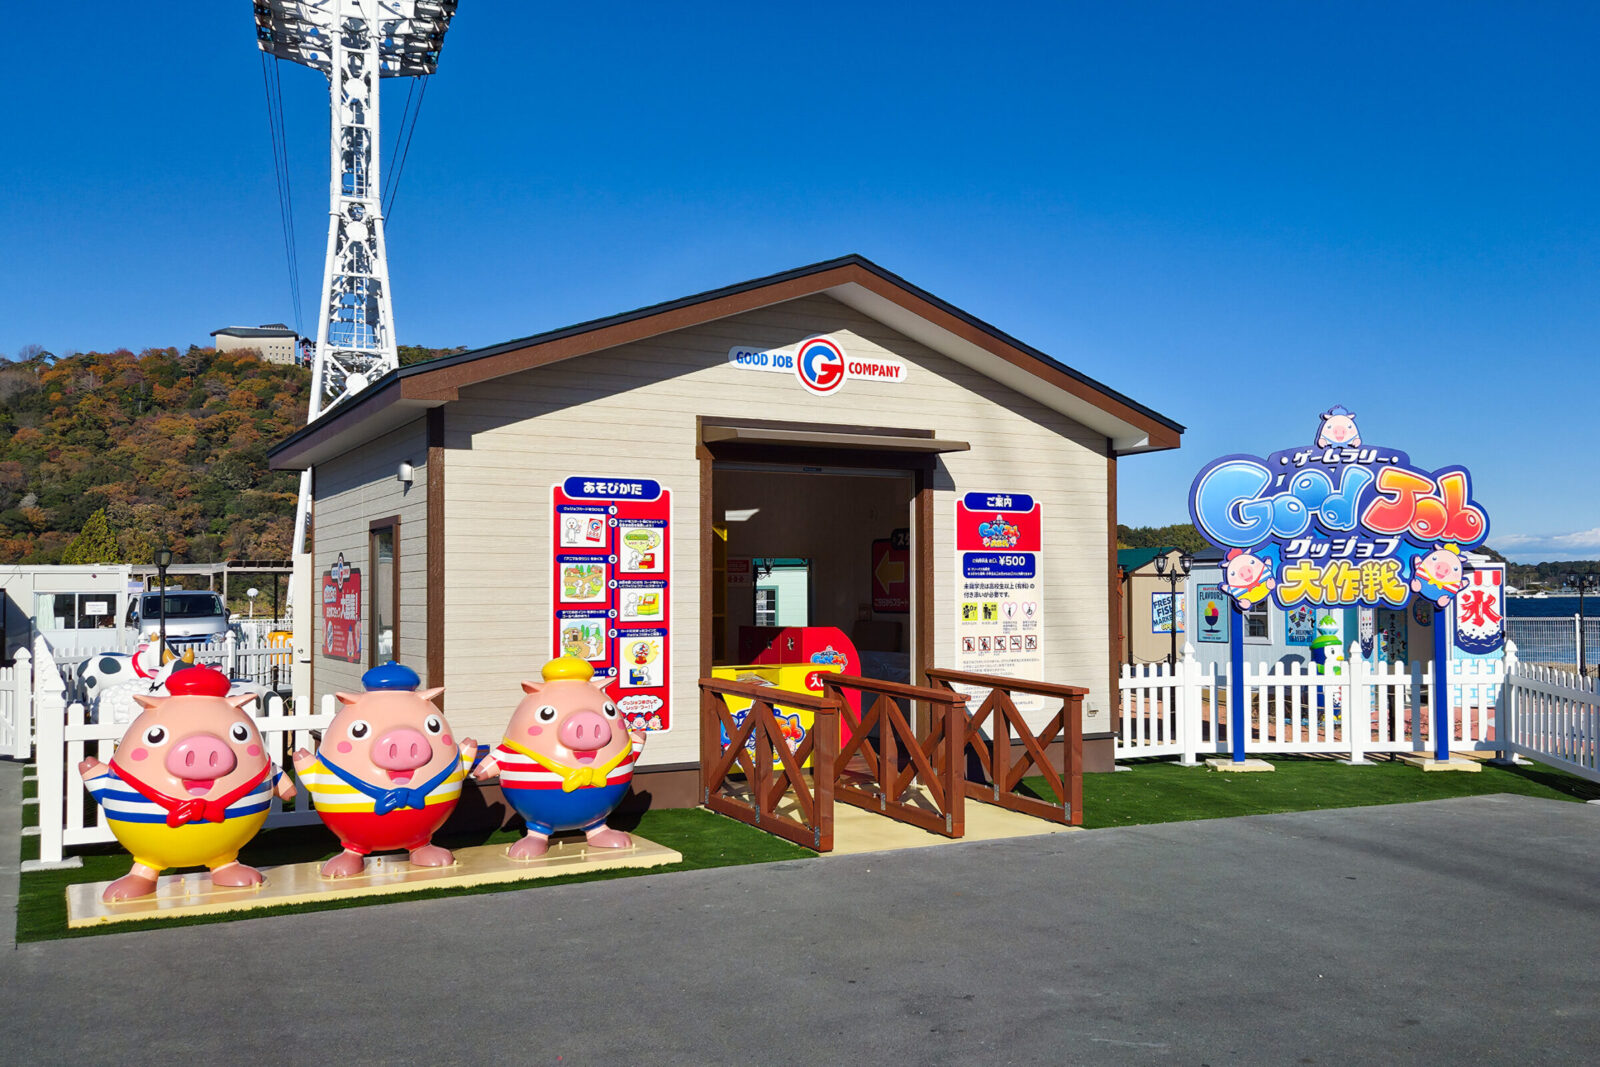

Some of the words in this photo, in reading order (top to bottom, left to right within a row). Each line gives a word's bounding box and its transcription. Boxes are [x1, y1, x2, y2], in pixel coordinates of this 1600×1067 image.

[736, 351, 769, 366] GOOD
[772, 354, 794, 368] JOB
[848, 362, 901, 378] COMPANY
[1293, 449, 1390, 466] ゲームラリー
[584, 482, 642, 496] あそびかた
[986, 496, 1012, 508] ご案内
[1196, 460, 1374, 547] Good
[1362, 466, 1486, 545] Job
[1284, 535, 1400, 558] グッジョブ
[999, 556, 1026, 566] ¥500
[1277, 559, 1410, 605] 大作戦
[1153, 596, 1173, 609] FRES
[1458, 590, 1503, 627] 氷
[1153, 614, 1173, 626] MARKE
